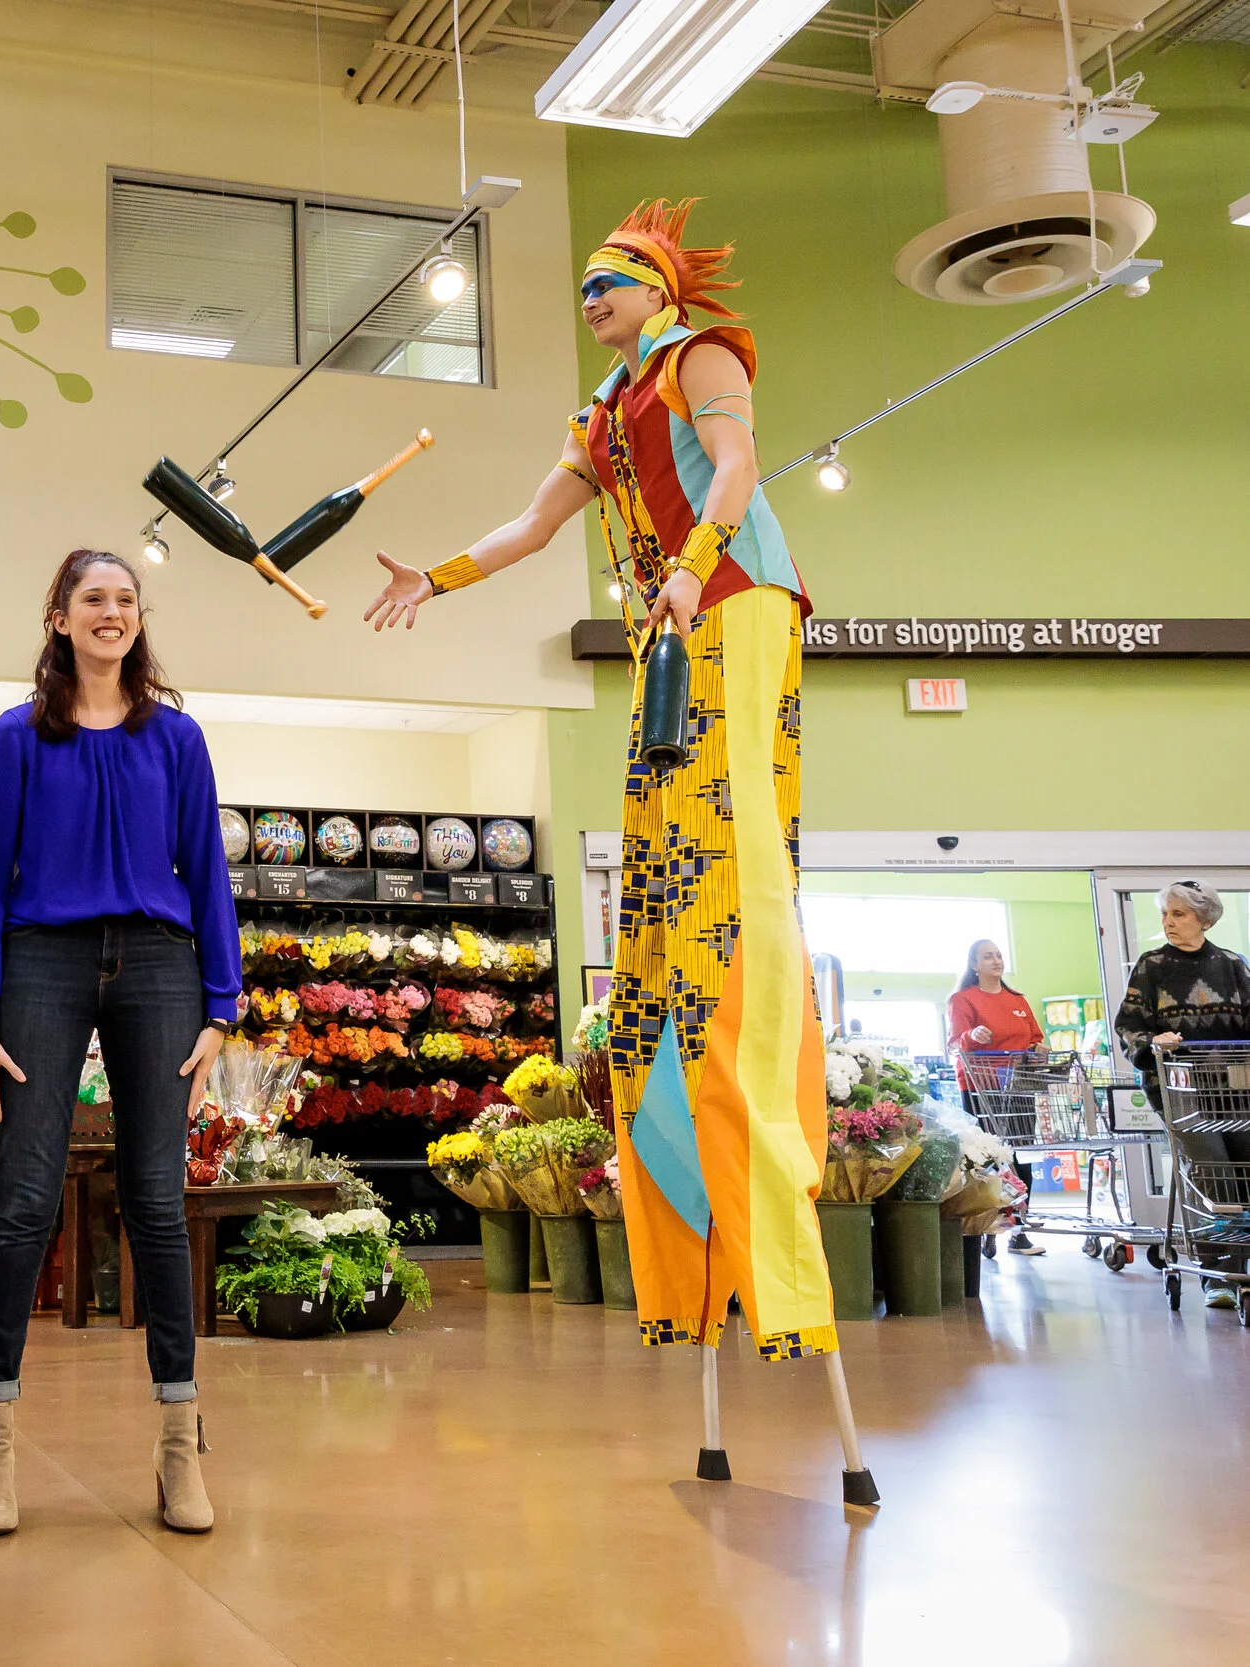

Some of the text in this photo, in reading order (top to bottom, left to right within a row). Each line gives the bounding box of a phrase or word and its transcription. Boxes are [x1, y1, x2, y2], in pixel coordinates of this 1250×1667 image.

[845, 616, 888, 645] for
[895, 616, 1025, 653] shopping
[1032, 618, 1062, 645] at
[1070, 618, 1163, 653] Kroger
[920, 679, 957, 708] EXIT
[273, 883, 290, 895] $15
